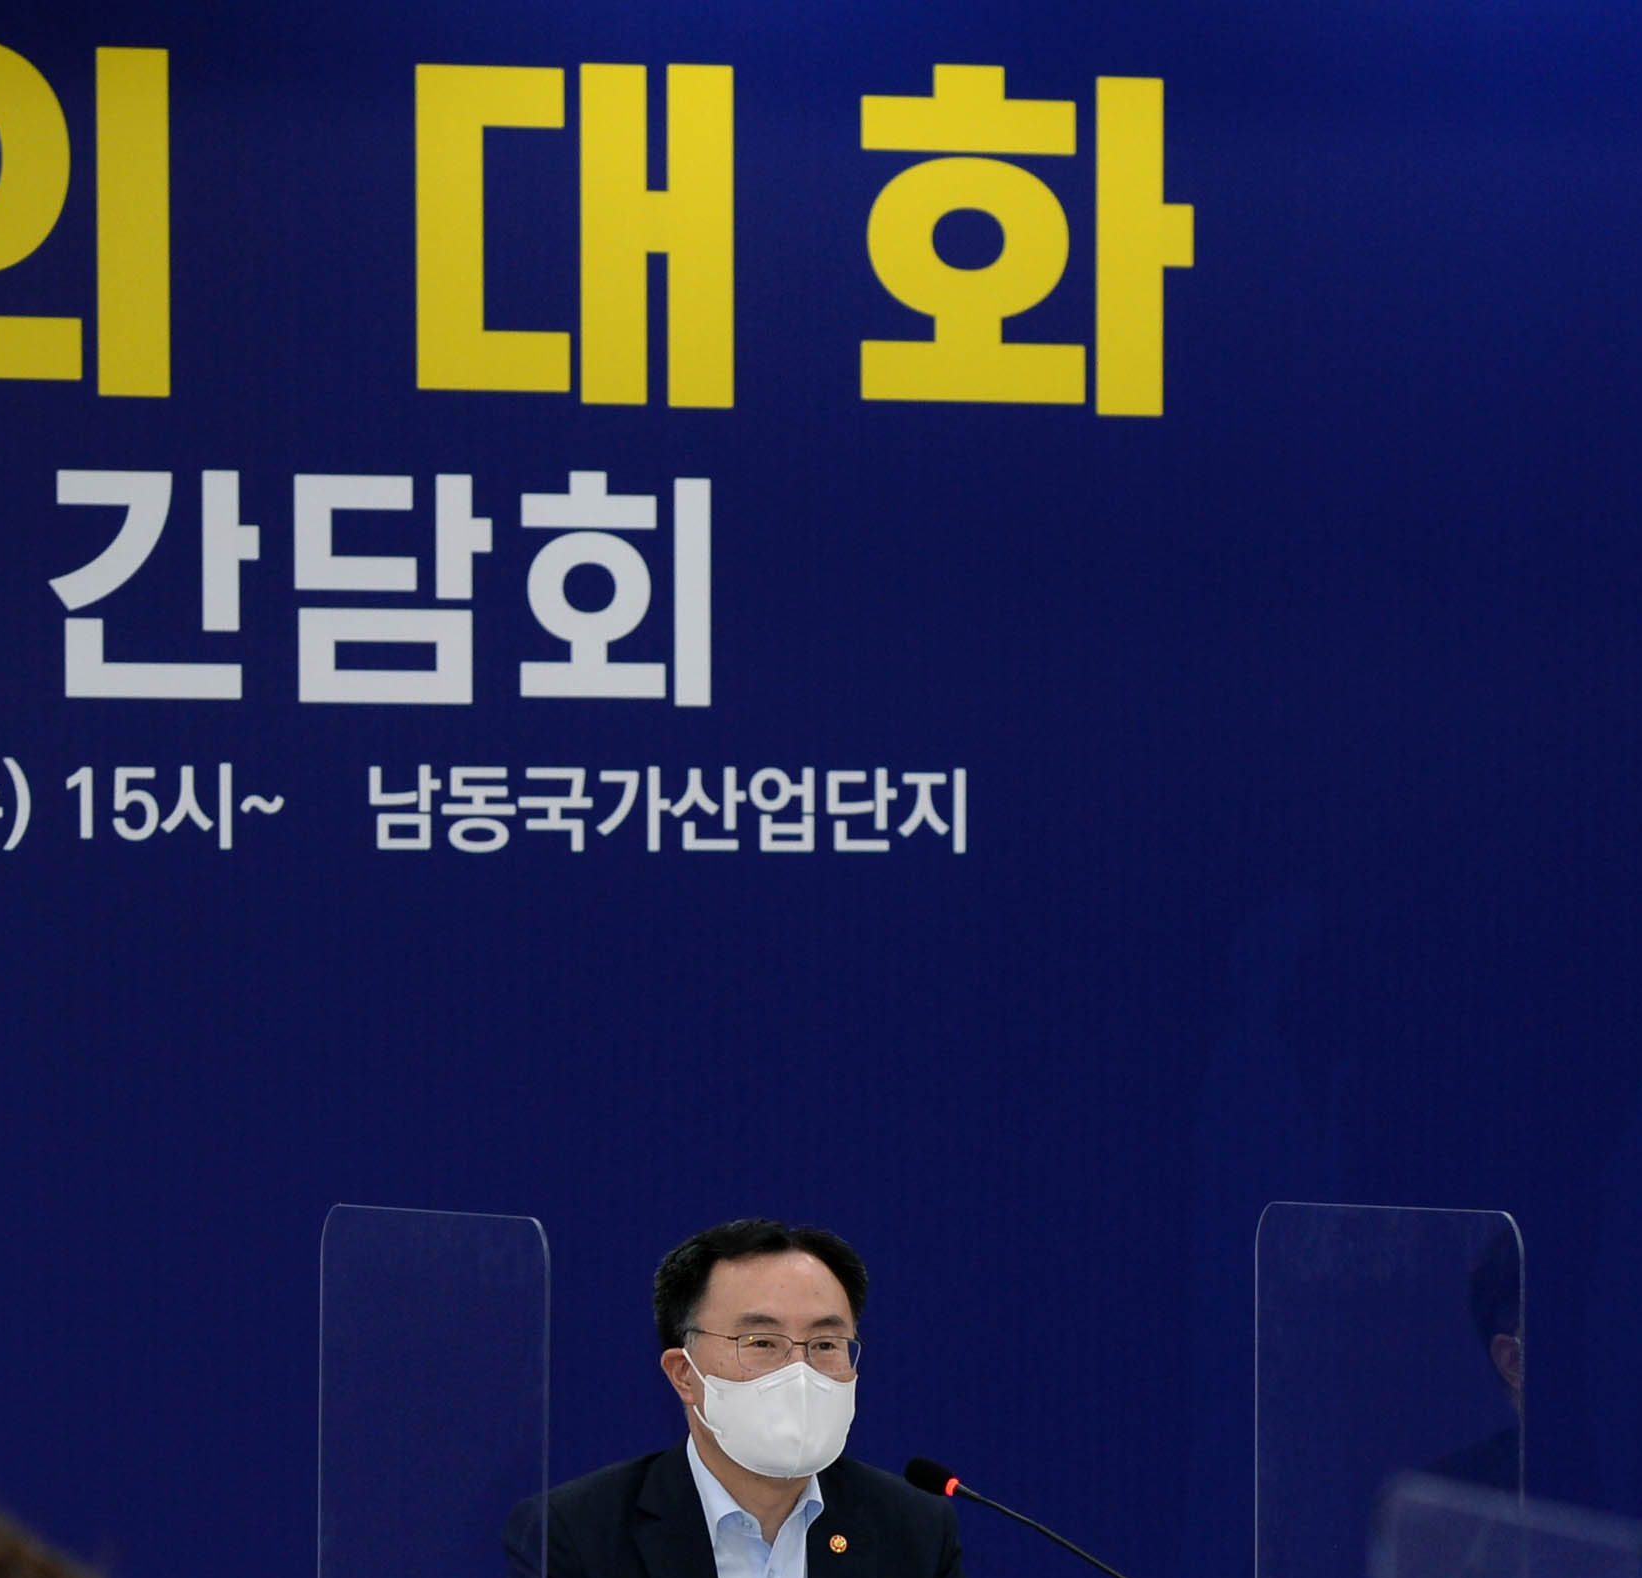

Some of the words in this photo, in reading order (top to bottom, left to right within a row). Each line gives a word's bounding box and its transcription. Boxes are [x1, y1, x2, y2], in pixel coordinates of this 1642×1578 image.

[414, 62, 1195, 417] 대화
[48, 469, 712, 708] 간담회
[65, 762, 285, 851] 15시~
[368, 763, 967, 854] 남동국가산업단지
